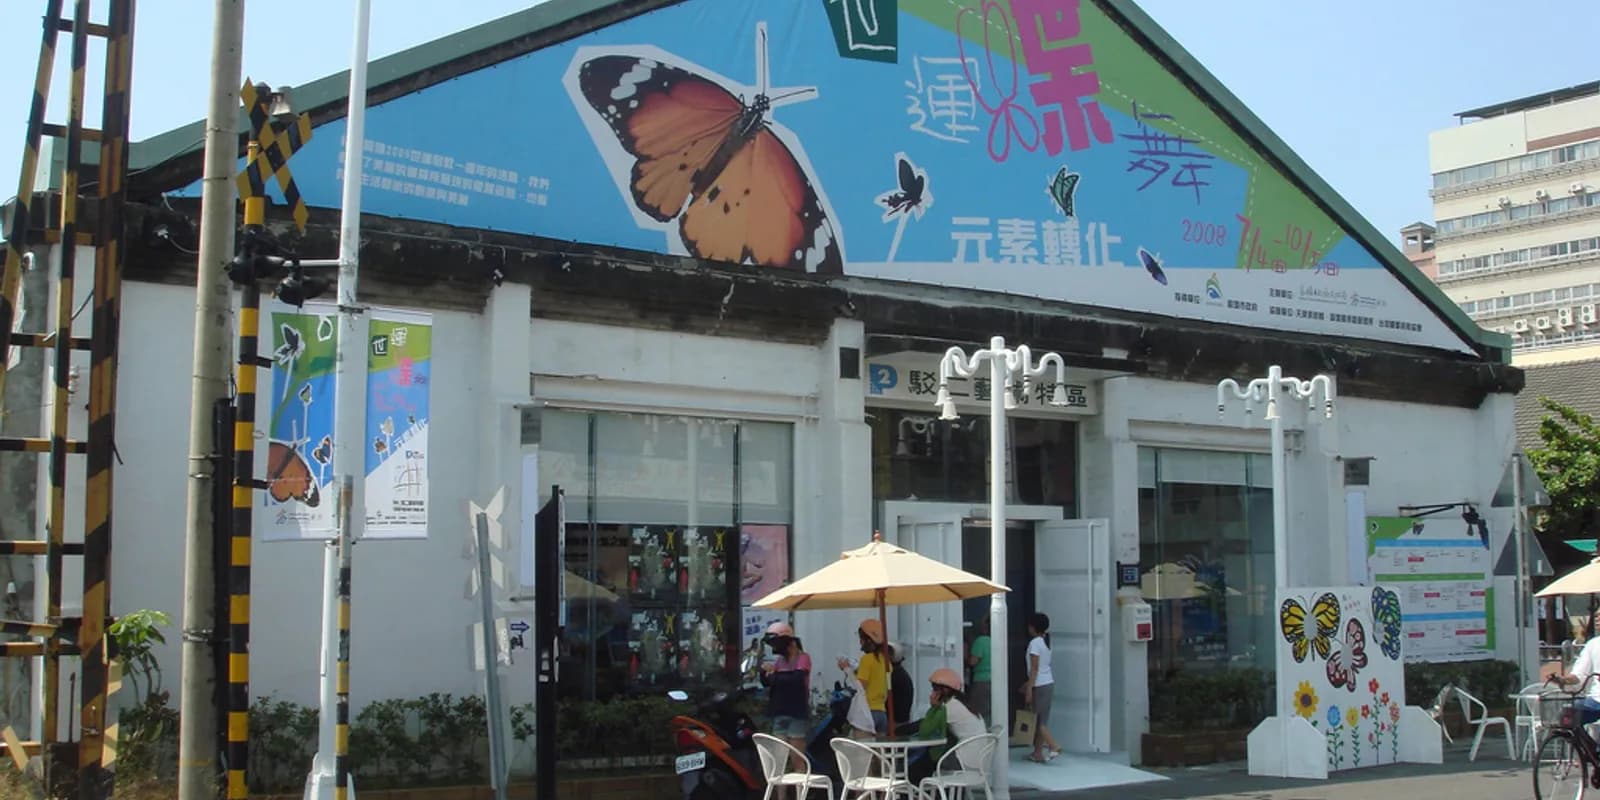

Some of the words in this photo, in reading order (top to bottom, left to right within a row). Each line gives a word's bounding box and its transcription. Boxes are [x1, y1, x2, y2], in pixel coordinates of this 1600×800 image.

[951, 216, 1124, 267] 元素轉化
[1182, 219, 1227, 247] 2008
